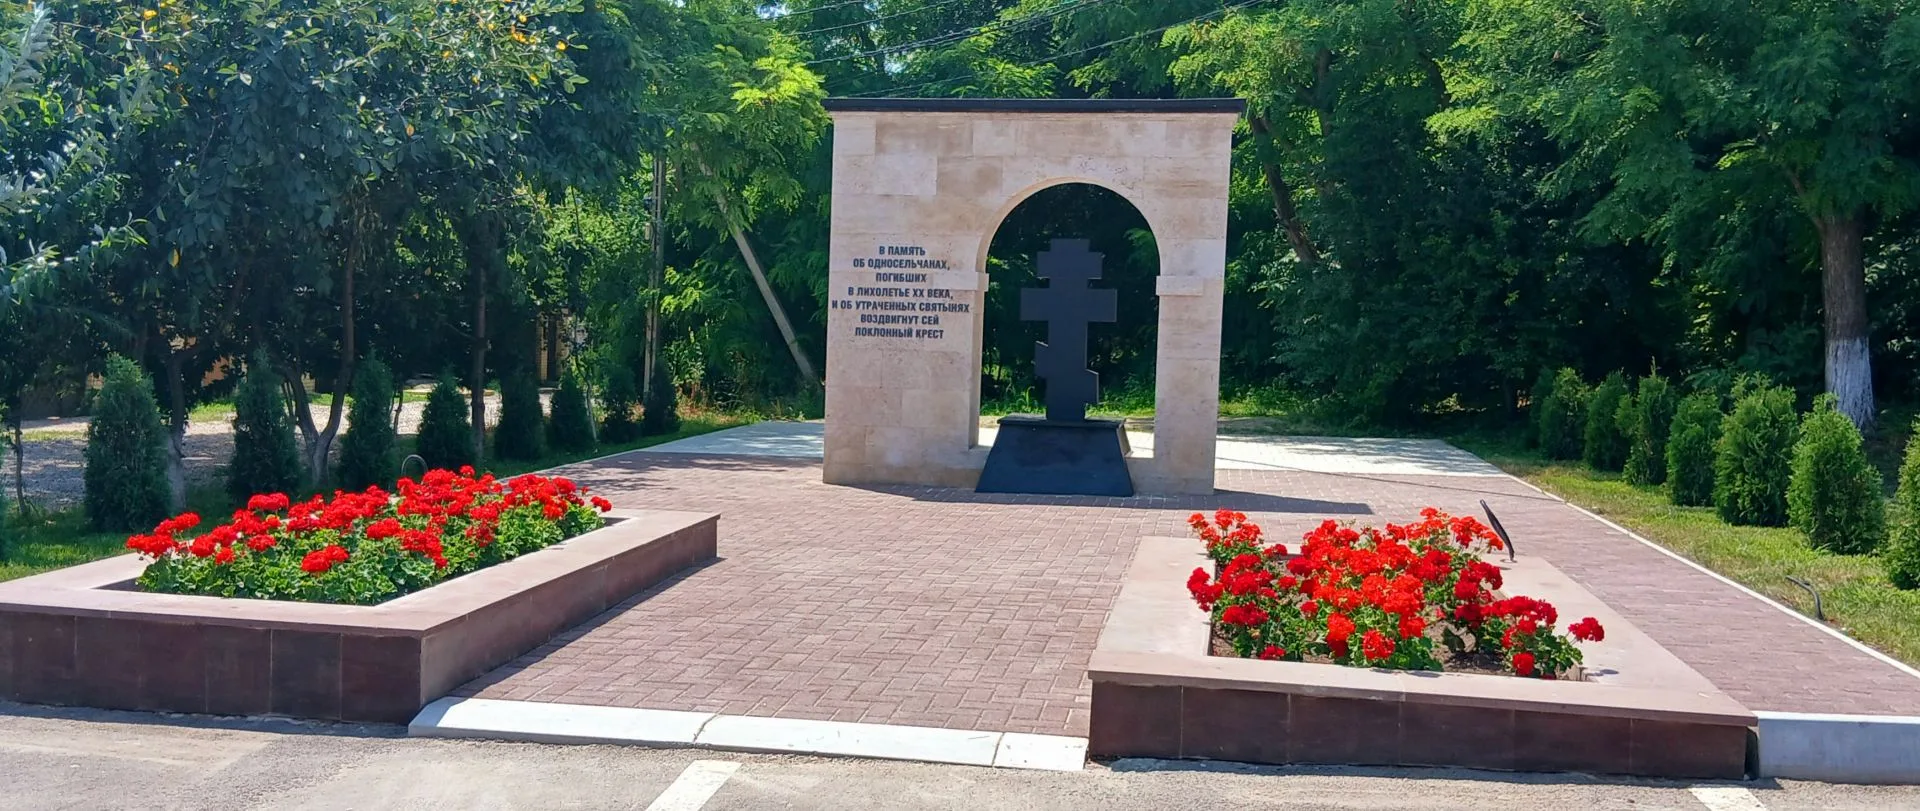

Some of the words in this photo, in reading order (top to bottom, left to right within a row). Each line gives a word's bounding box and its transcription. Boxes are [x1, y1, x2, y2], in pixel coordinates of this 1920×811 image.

[879, 246, 885, 255] В
[888, 246, 926, 256] ПАМЯТЬ
[853, 259, 865, 267] ОБ
[868, 259, 950, 270] ОДНОСЕЛЬЧАНАХ,
[876, 273, 926, 282] ПОГИБШИХ
[848, 287, 854, 296] В
[857, 287, 910, 297] ЛИХОЛЕТЬЕ
[928, 289, 953, 299] ВЕКА,
[832, 300, 838, 308] И
[841, 300, 852, 309] ОБ
[855, 301, 916, 311] УТРАЧЕННЫХ
[919, 303, 969, 312] СВЯТЫНЯХ
[861, 314, 918, 325] ВОЗДВИГНУТ
[922, 314, 939, 325] СЕЙ
[855, 326, 913, 337] ПОКЛОННЫЙ
[916, 329, 944, 339] КРЕСТ
